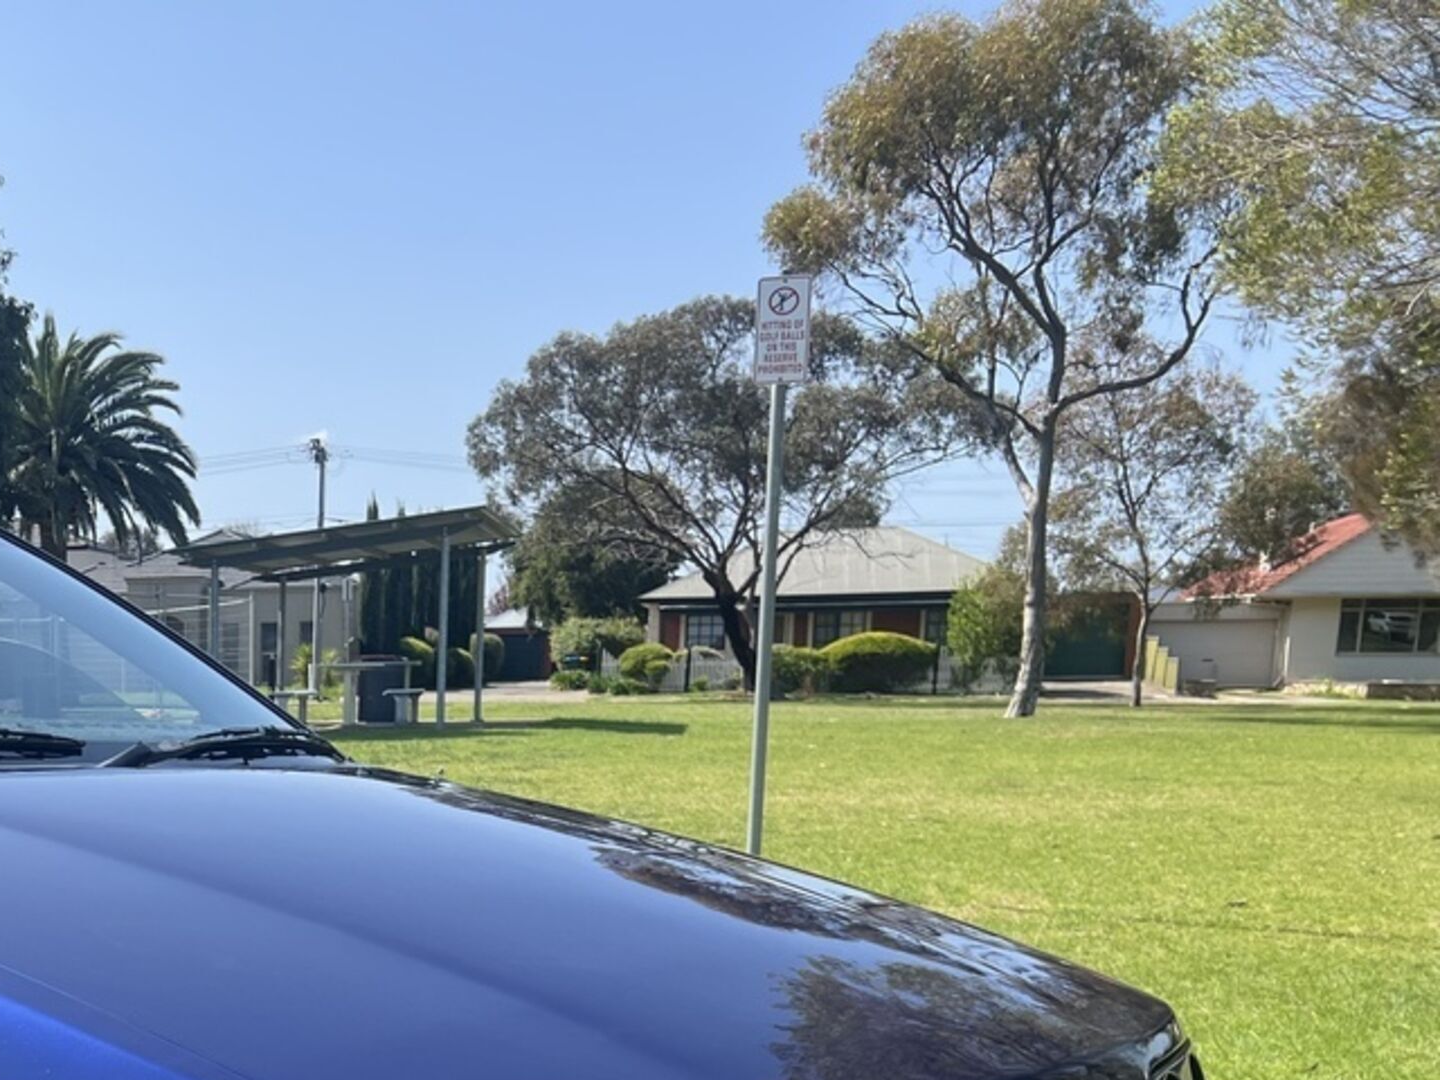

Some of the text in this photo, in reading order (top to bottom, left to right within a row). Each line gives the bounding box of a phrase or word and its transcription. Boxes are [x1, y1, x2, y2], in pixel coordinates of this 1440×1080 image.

[794, 319, 804, 329] OF
[781, 330, 804, 340] BALLS
[780, 341, 797, 351] THIS
